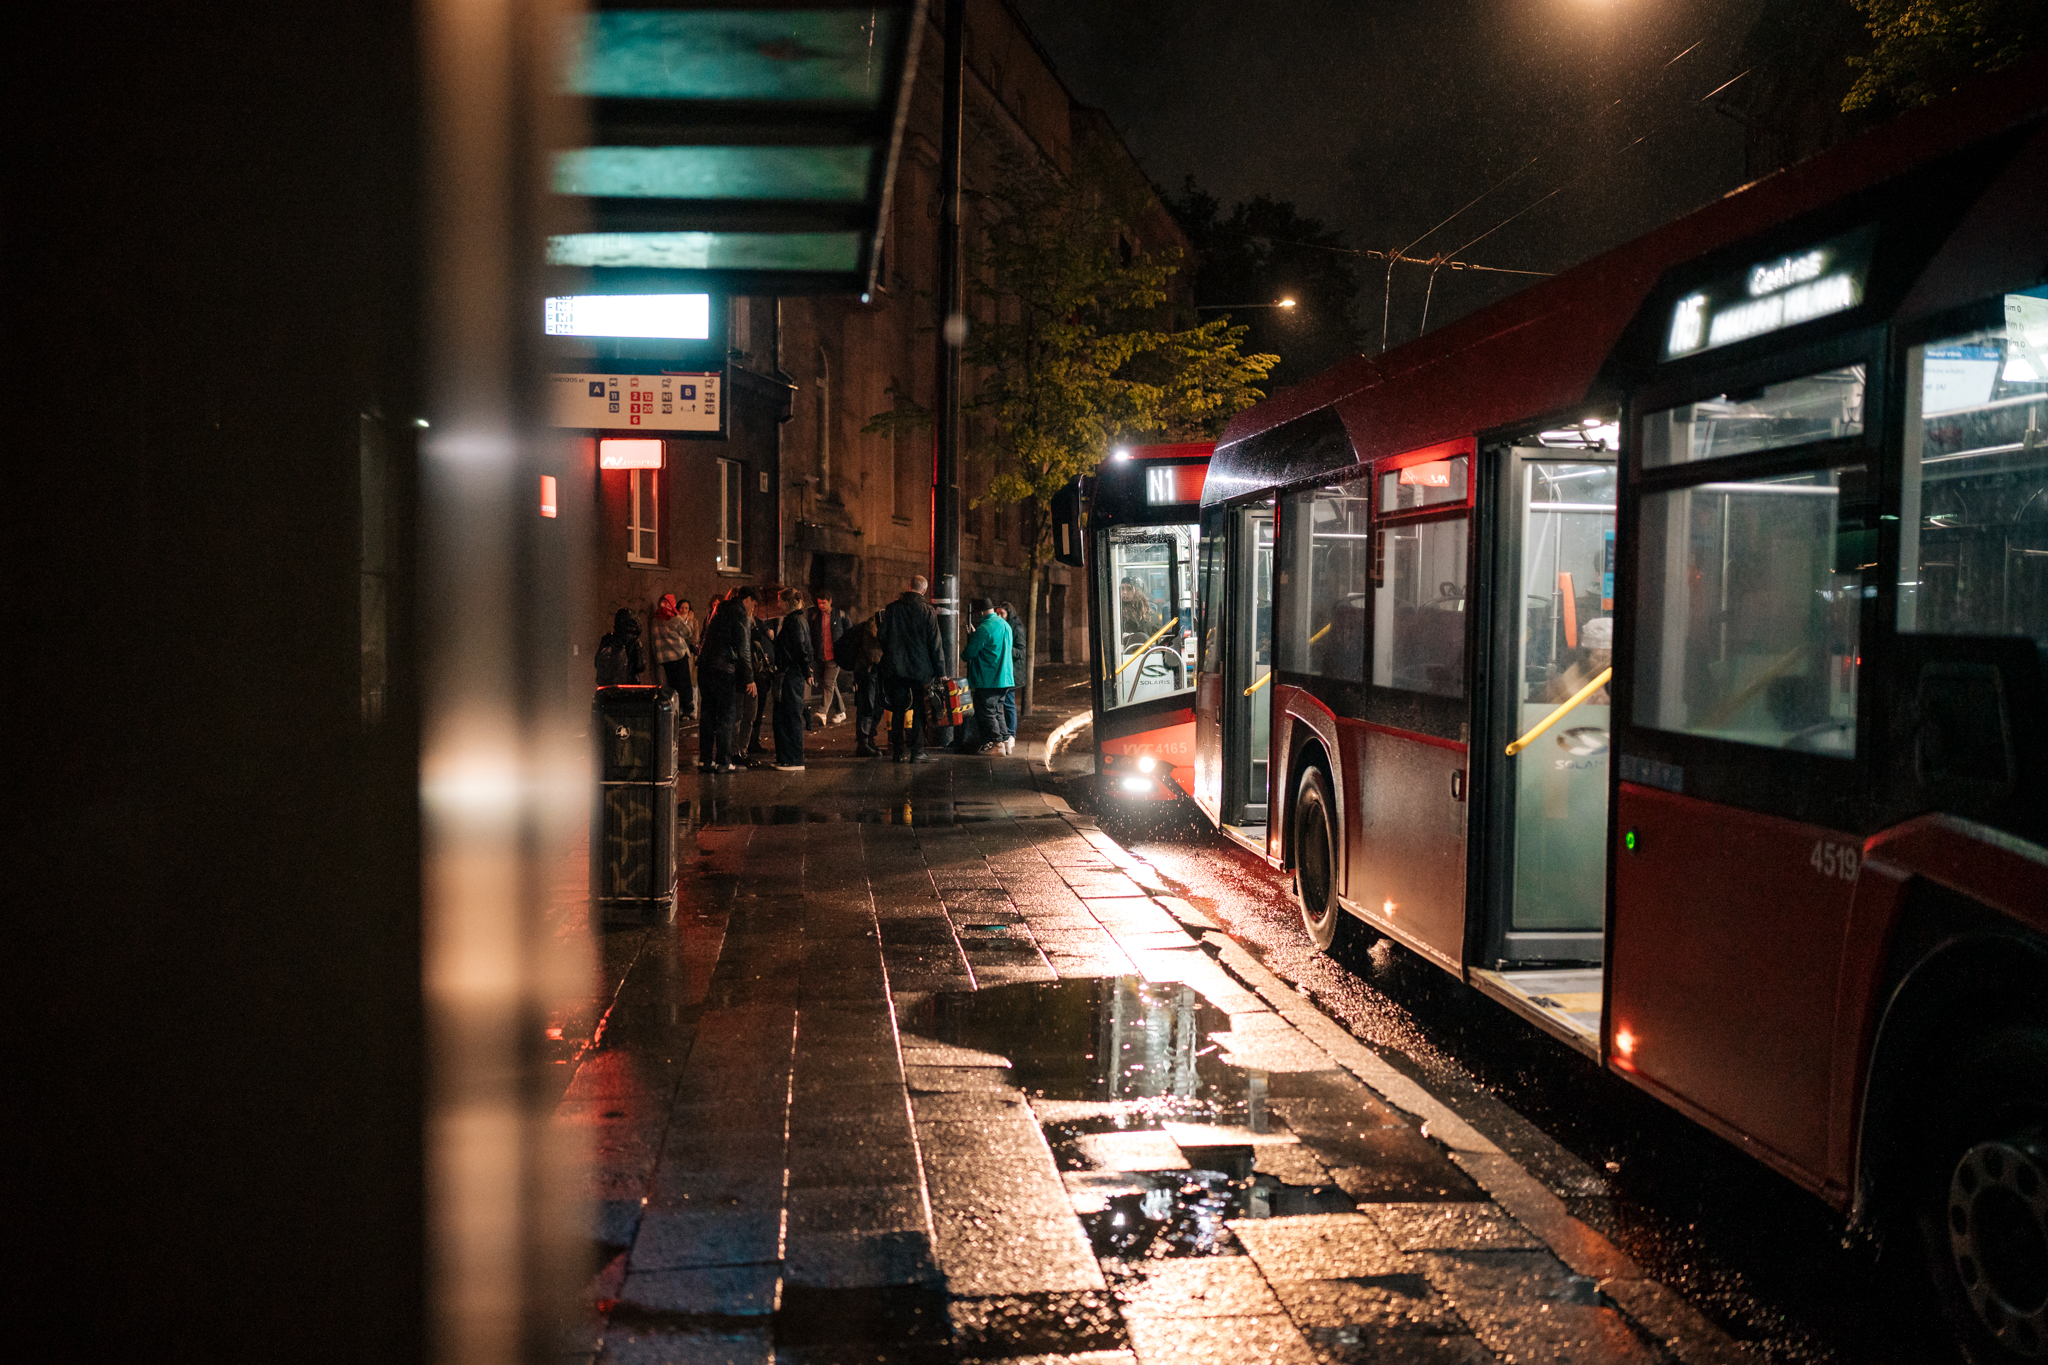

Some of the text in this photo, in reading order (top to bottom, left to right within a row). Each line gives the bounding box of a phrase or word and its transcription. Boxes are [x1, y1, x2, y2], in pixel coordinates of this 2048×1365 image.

[592, 385, 602, 394] A
[684, 388, 692, 396] B
[643, 393, 653, 401] 12
[662, 393, 673, 401] N1
[643, 405, 654, 413] 20
[632, 416, 639, 424] 6
[1149, 469, 1175, 501] N1
[1155, 742, 1187, 754] 4165
[1555, 759, 1604, 770] SOLA
[1810, 841, 1858, 881] 4519
